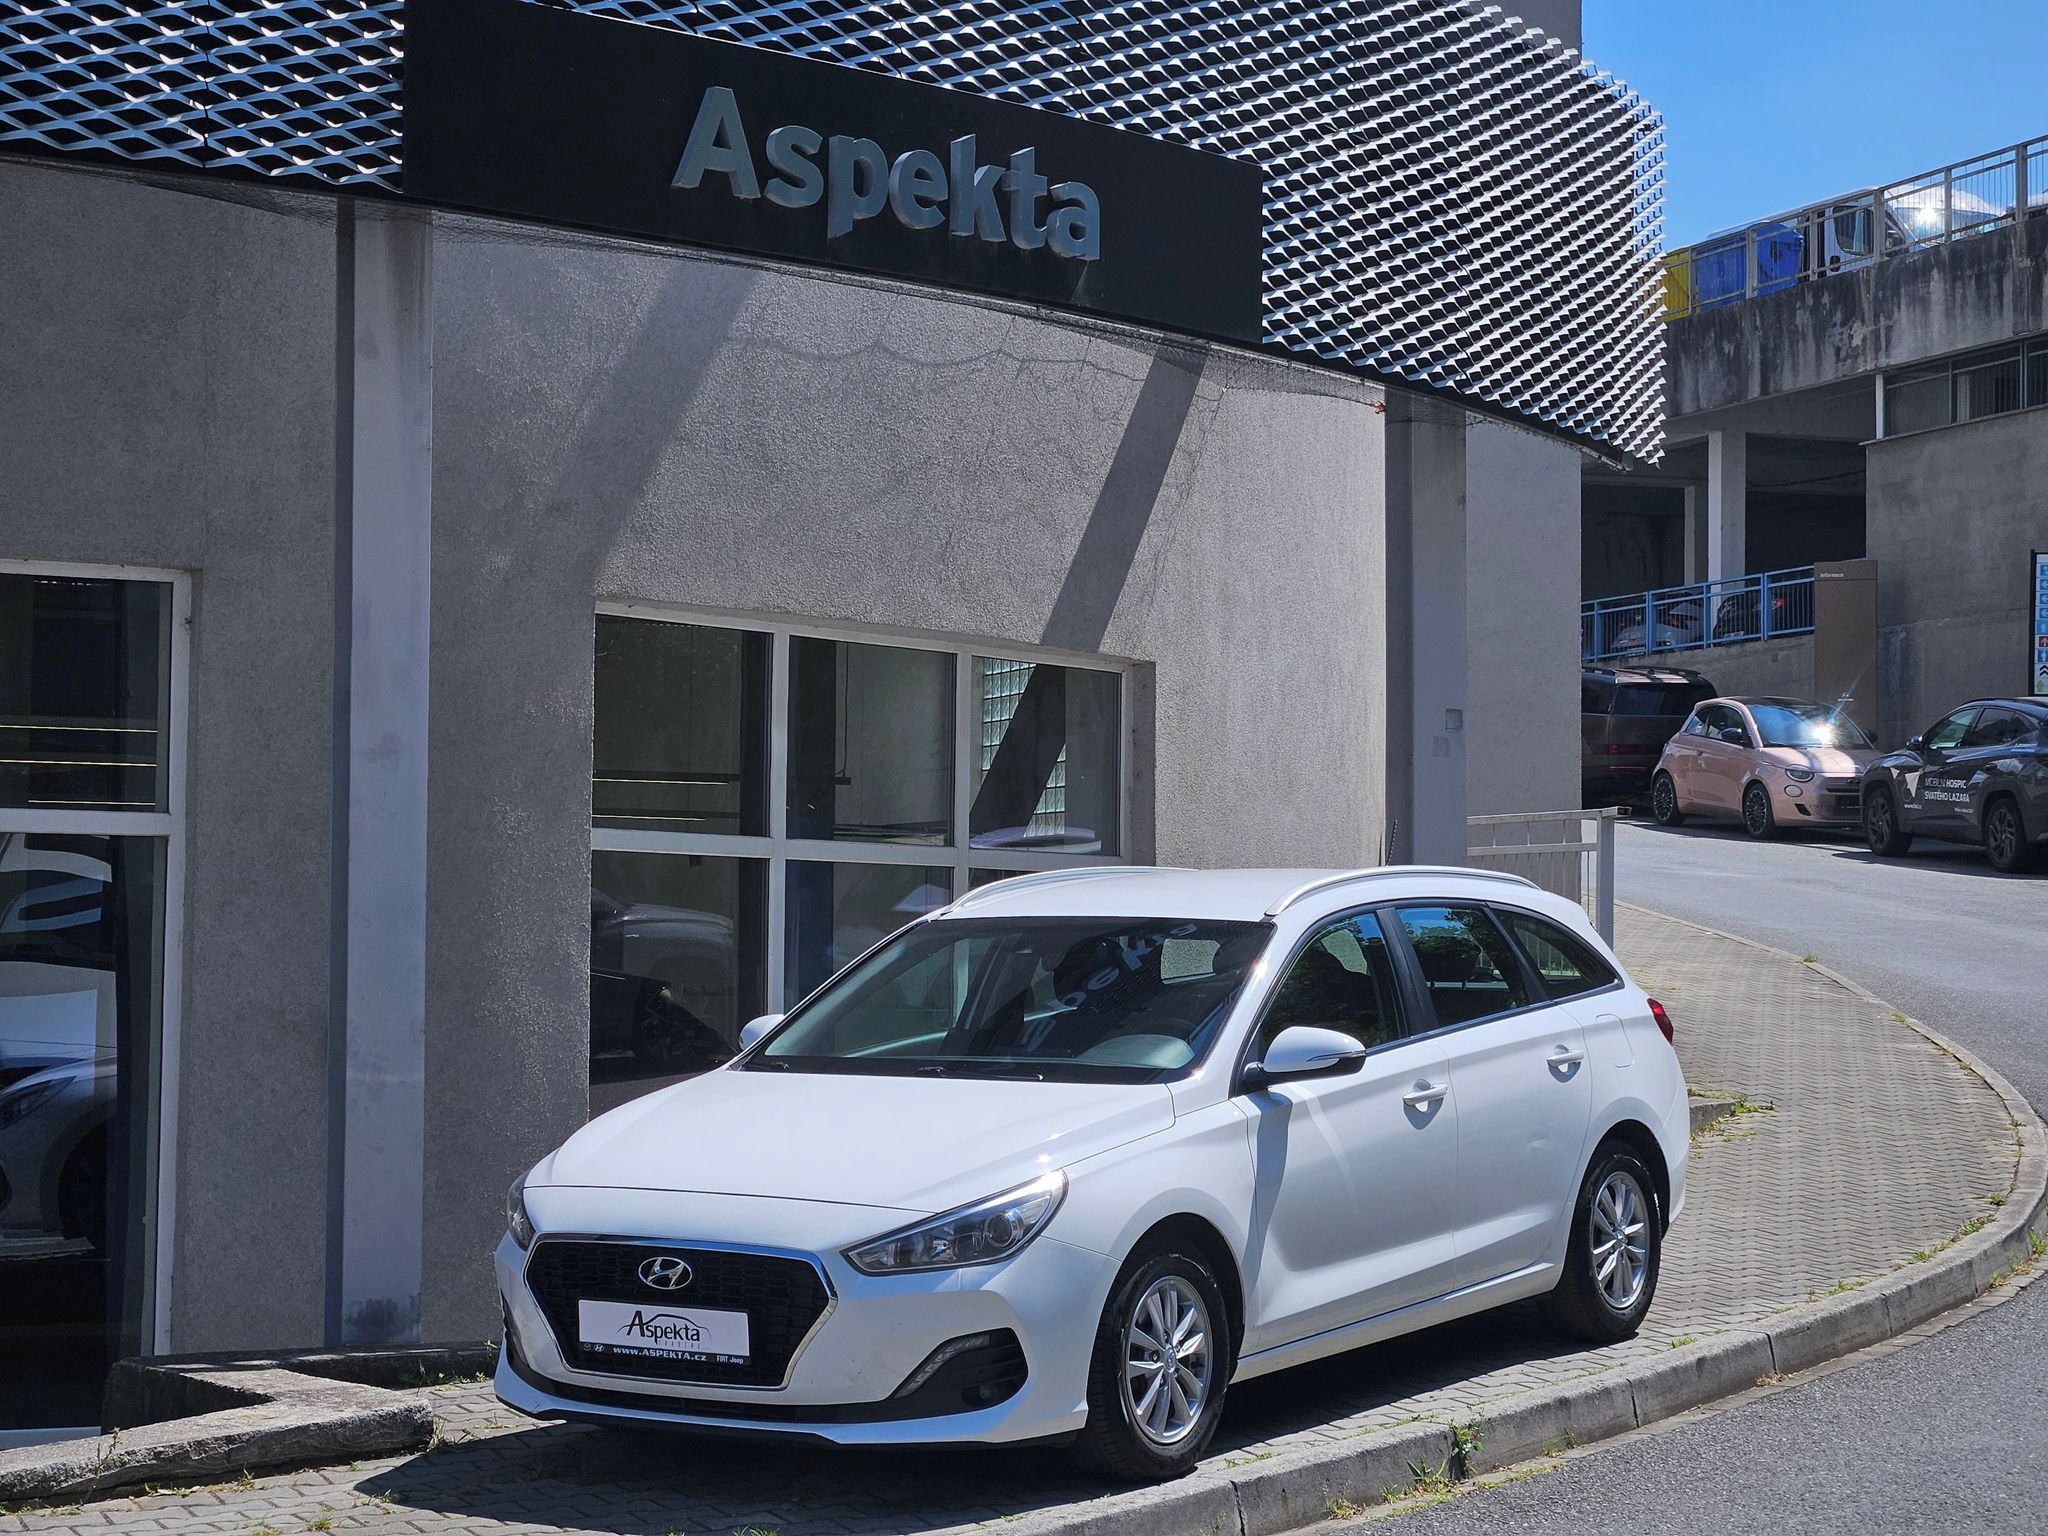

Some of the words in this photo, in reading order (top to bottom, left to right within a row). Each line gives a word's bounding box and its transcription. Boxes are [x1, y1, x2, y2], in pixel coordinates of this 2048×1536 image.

[671, 86, 1101, 261] Aspekta
[1946, 779, 1967, 789] HOSPIC
[1924, 790, 1948, 801] SVATÉHO
[1949, 792, 1970, 803] LAZARA
[627, 1310, 700, 1345] Aspekta
[613, 1347, 707, 1362] www.ASPEKTA.cz
